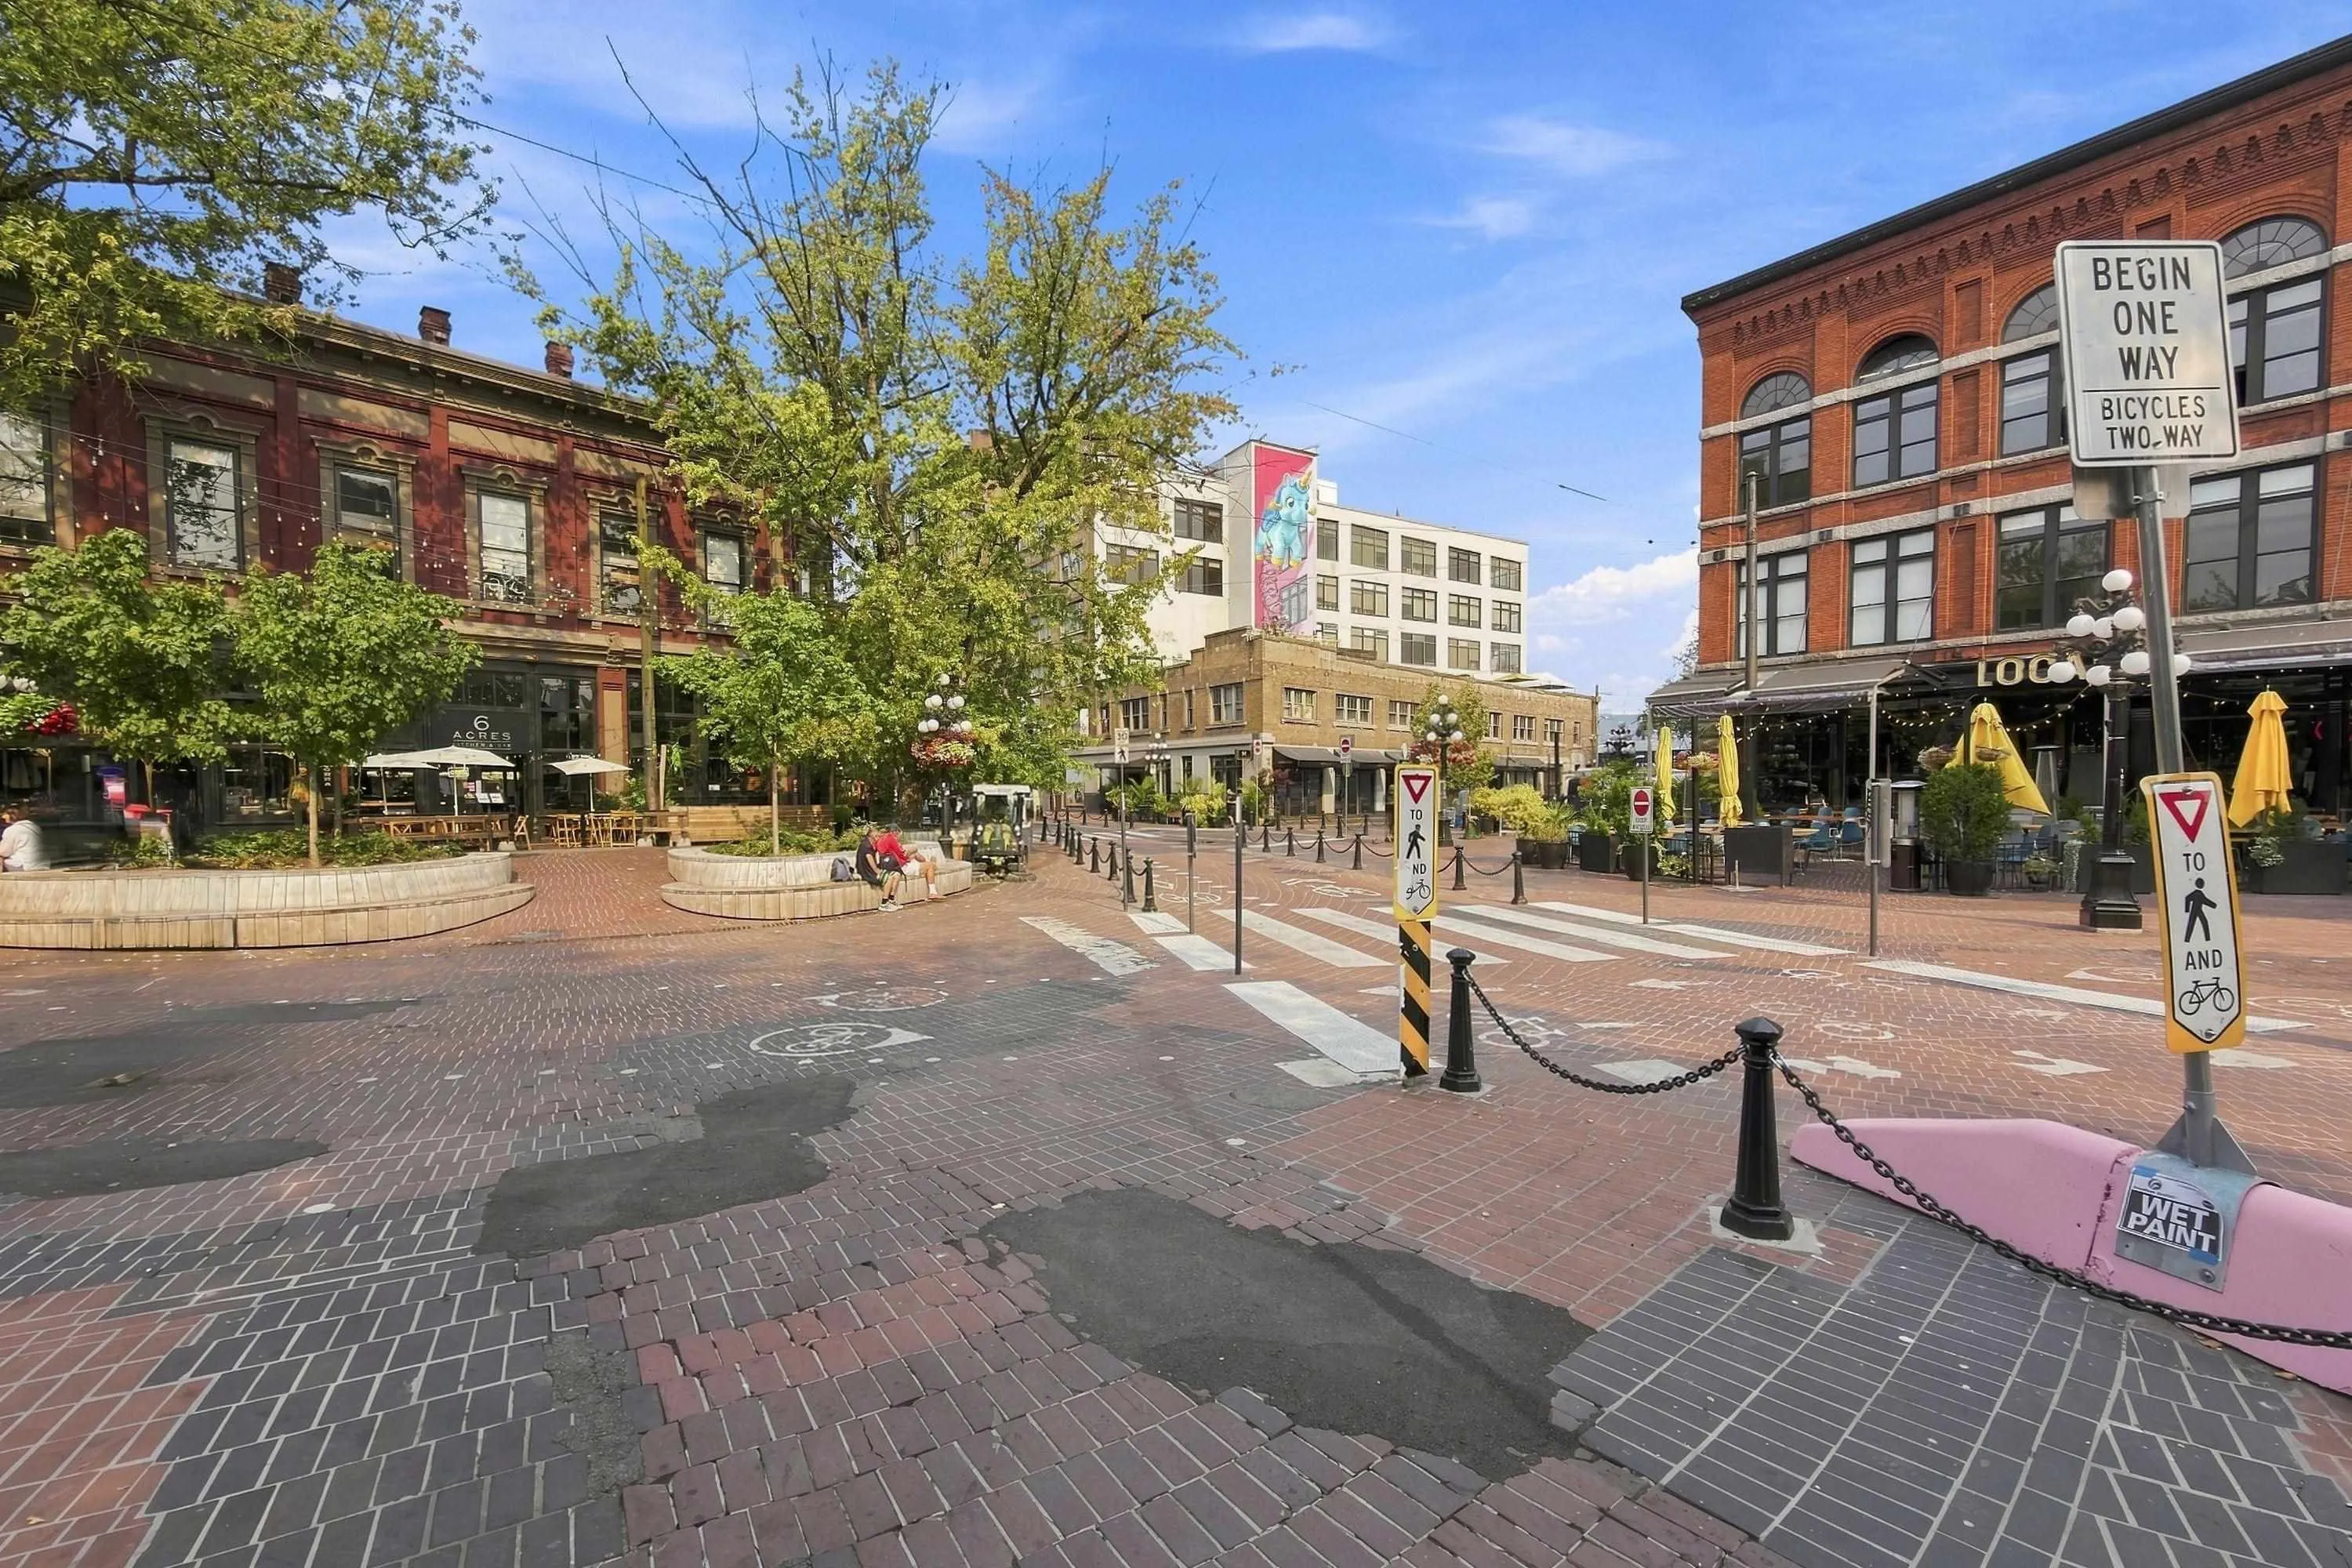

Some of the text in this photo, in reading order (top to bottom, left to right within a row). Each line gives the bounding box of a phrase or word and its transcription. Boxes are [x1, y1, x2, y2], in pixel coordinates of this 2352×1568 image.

[2092, 256, 2191, 292] BEGIN
[2114, 300, 2179, 336] ONE
[2118, 346, 2179, 381] WAY
[2101, 395, 2206, 421] BICYCLES
[2106, 424, 2203, 450] TWO WAY
[452, 731, 511, 741] ACRES
[474, 715, 490, 731] 6
[1410, 809, 1423, 821] TO
[2183, 851, 2205, 872] TO
[2185, 949, 2223, 971] AND
[2141, 1193, 2210, 1232] WET
[2126, 1211, 2216, 1253] PAINT
